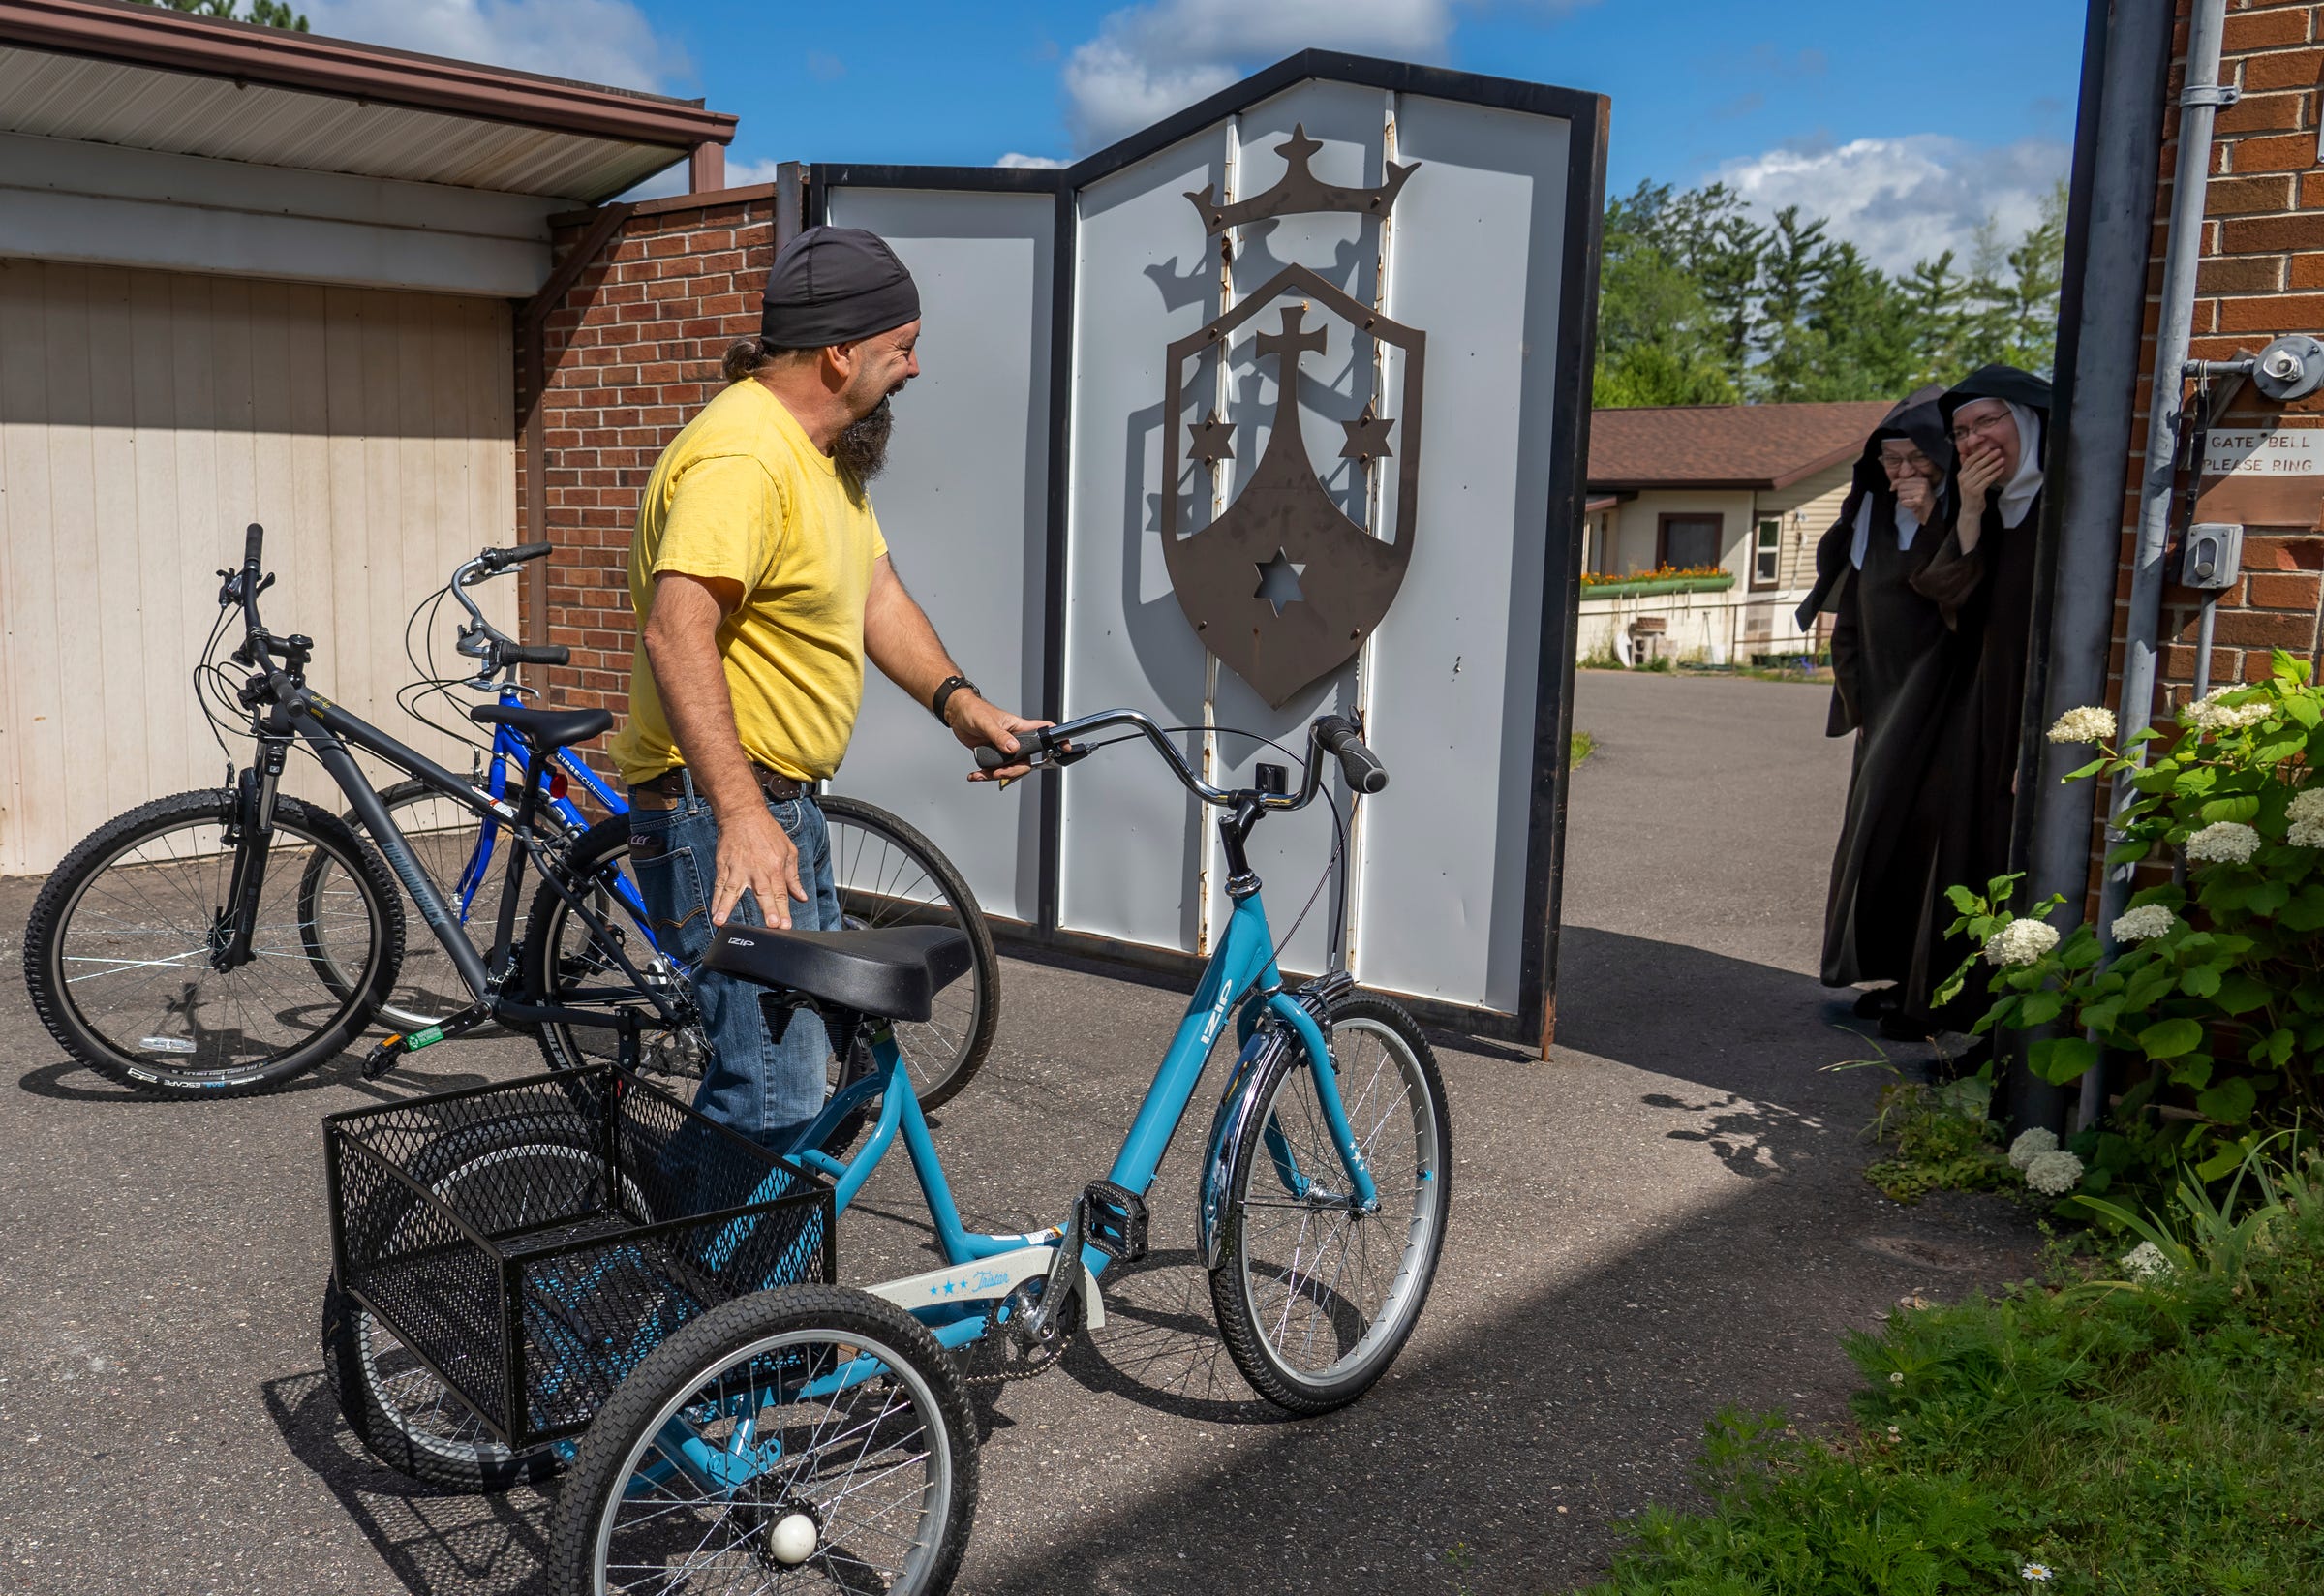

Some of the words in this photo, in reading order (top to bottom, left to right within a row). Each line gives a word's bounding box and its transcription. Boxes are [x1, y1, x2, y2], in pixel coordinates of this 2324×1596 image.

[2212, 437, 2254, 447] GATE
[2268, 437, 2310, 447] BELL
[2202, 459, 2262, 471] PLEASE
[2273, 459, 2312, 471] RING
[381, 842, 449, 927] DIAMONDBACK
[728, 937, 755, 946] IZIP
[1201, 979, 1232, 1044] IZIP
[163, 1079, 201, 1089] ESCAPE
[971, 1270, 1010, 1293] Tristar
